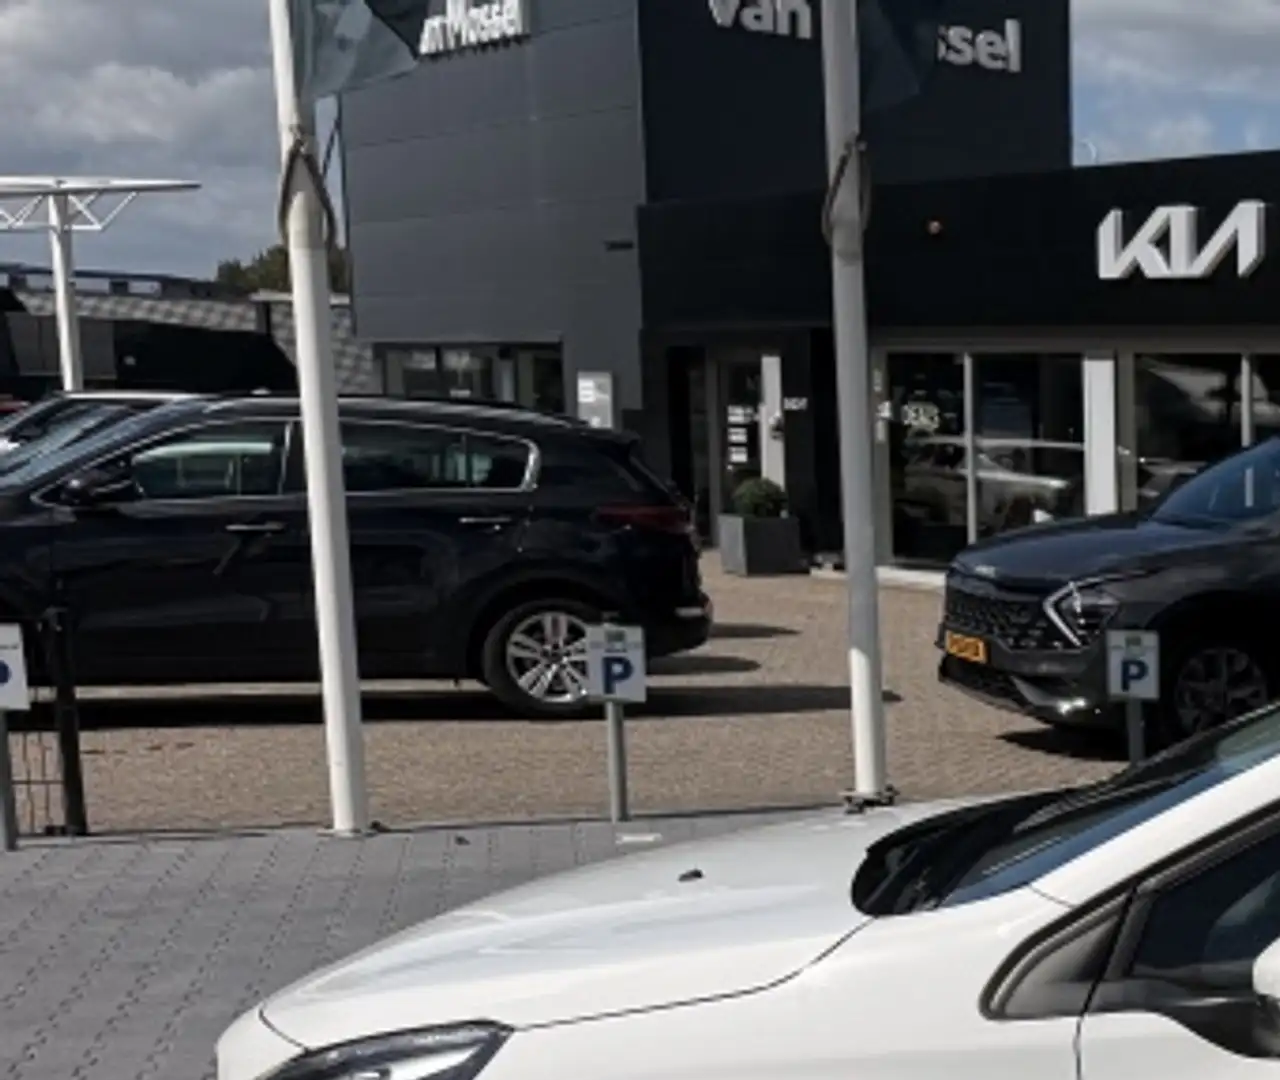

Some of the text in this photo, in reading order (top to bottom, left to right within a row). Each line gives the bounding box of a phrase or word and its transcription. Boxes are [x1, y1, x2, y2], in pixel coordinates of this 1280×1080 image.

[938, 18, 1021, 73] sel
[1096, 200, 1267, 281] KIA
[602, 656, 634, 695] P
[1121, 660, 1148, 692] P
